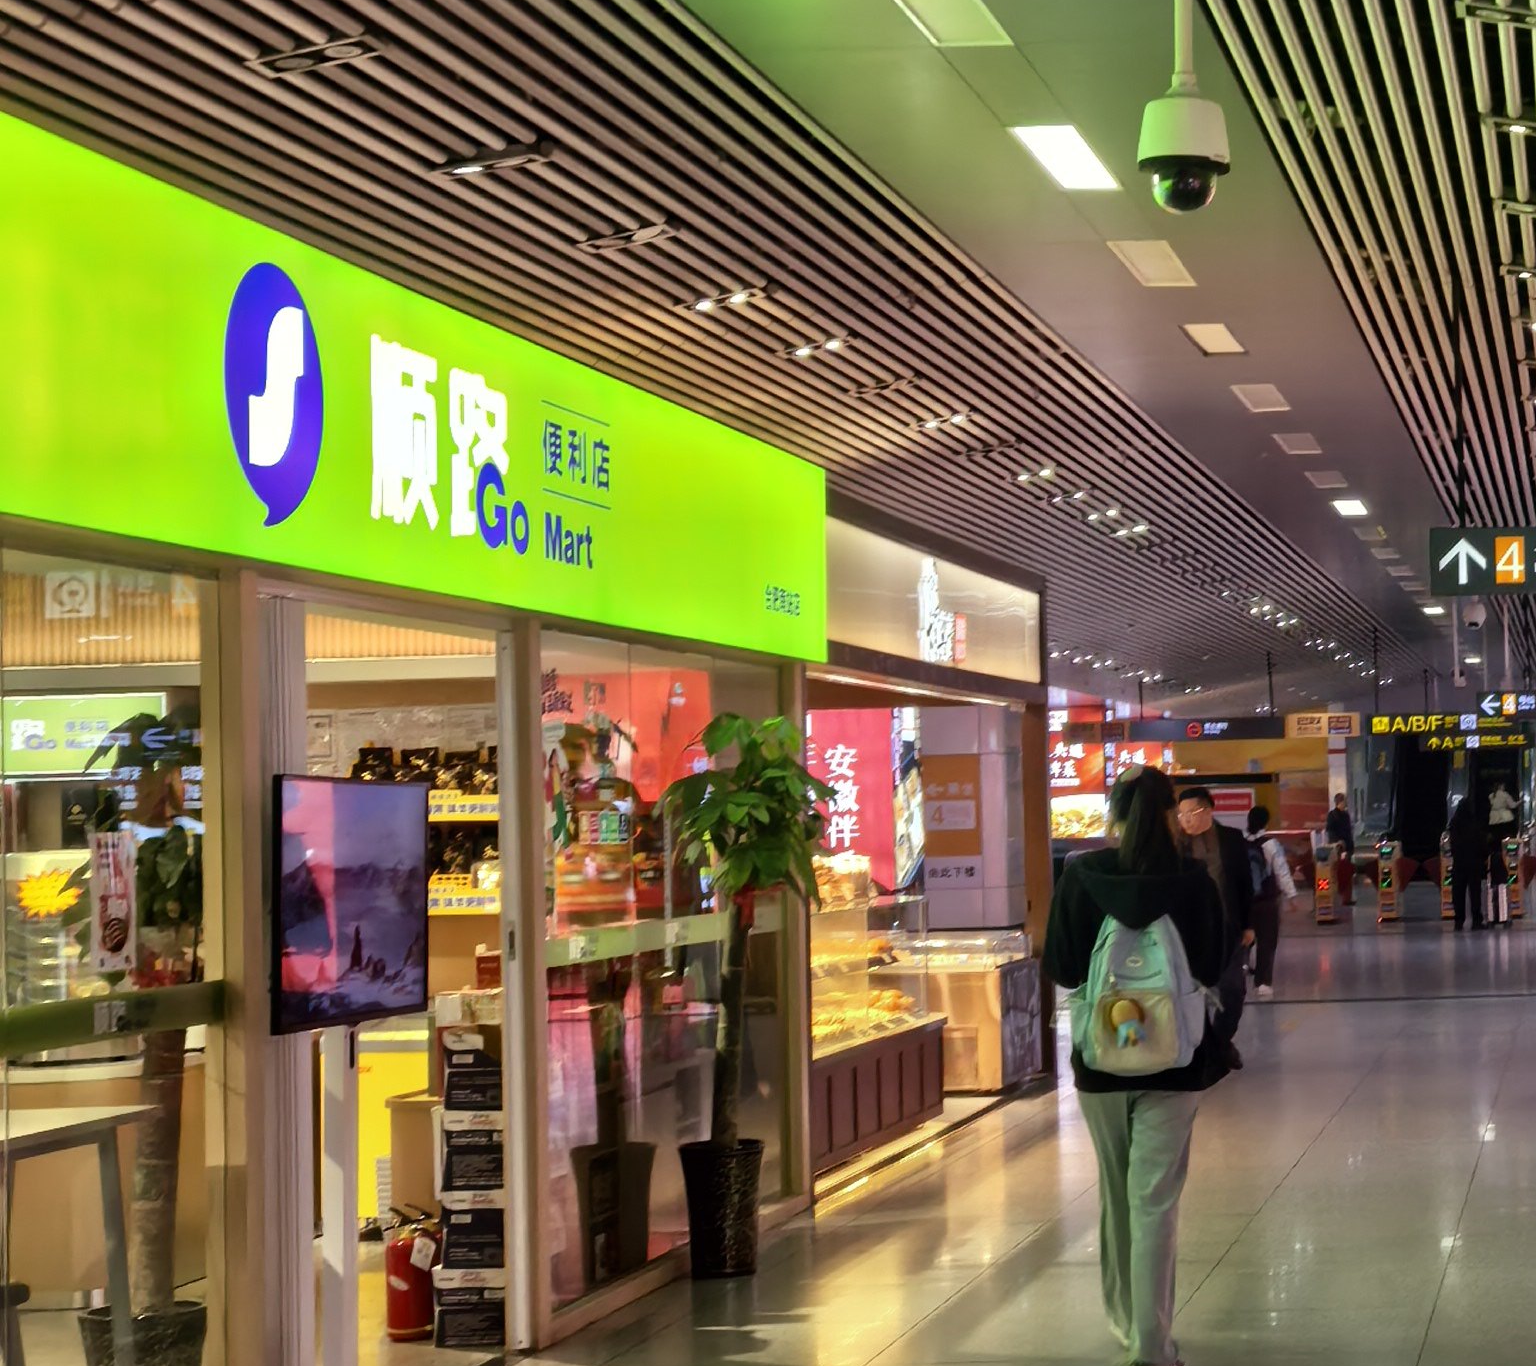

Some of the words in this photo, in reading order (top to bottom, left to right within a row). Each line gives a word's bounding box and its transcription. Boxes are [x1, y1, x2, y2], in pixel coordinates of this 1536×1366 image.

[542, 418, 611, 492] 便利店
[476, 461, 530, 555] Go
[544, 511, 593, 570] Mart
[1496, 541, 1525, 582] 4
[1502, 693, 1516, 713] 4
[824, 744, 861, 857] 安徽伴
